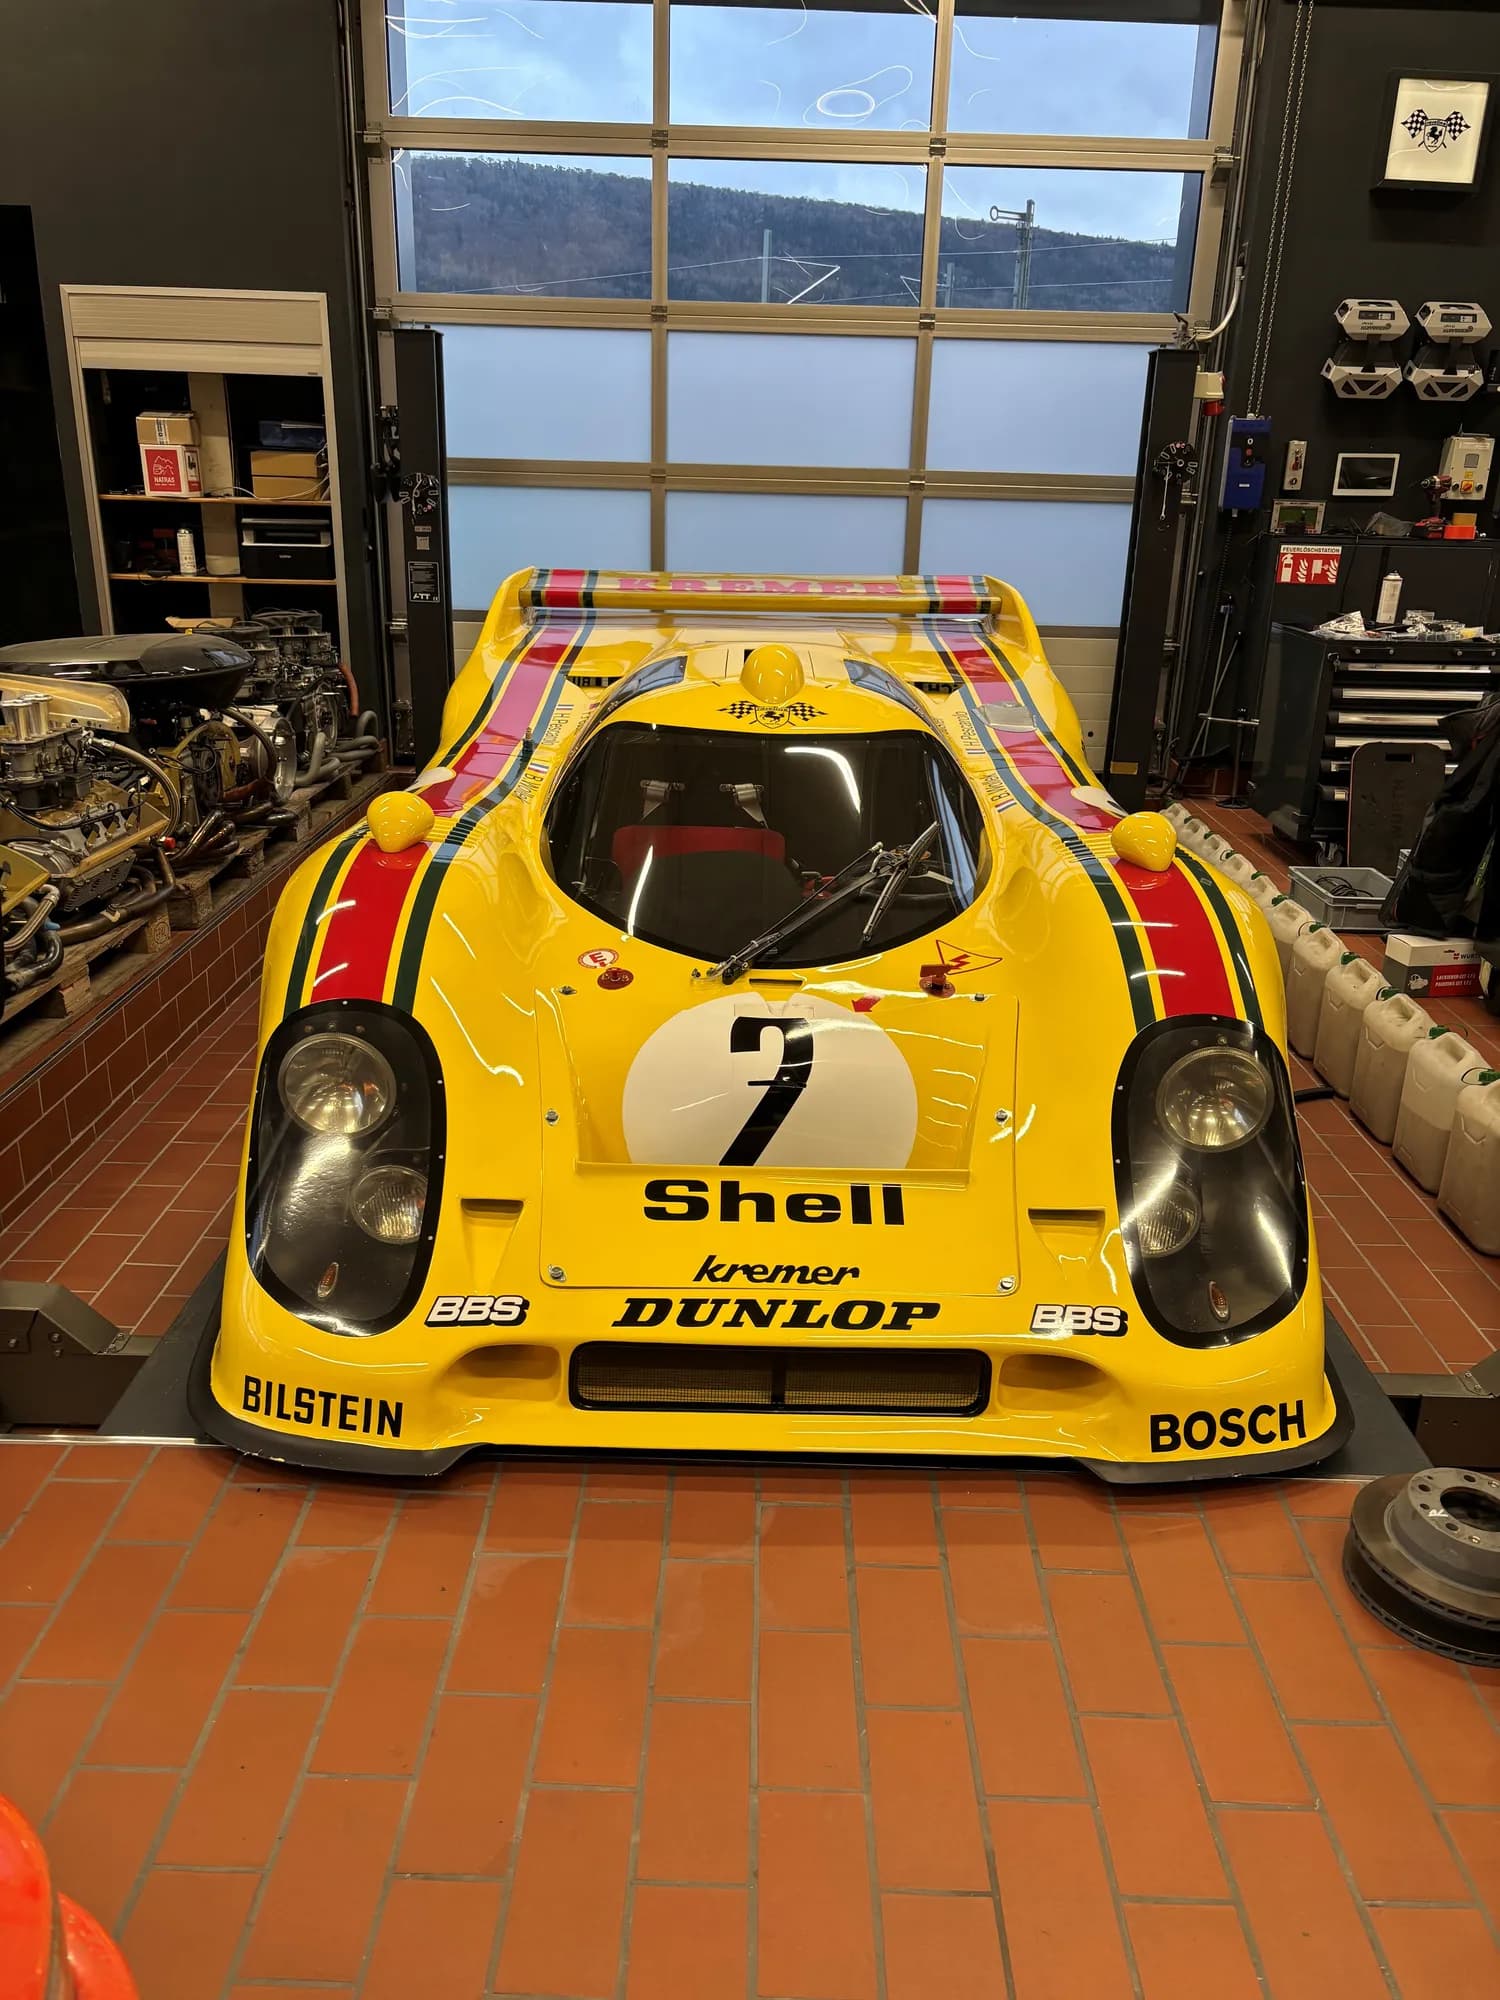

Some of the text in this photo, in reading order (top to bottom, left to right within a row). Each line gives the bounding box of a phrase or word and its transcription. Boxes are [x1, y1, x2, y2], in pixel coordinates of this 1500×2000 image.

[618, 578, 899, 596] KREMER
[643, 1179, 905, 1226] Shell
[692, 1254, 861, 1285] kremer
[424, 1295, 529, 1327] BBS
[611, 1297, 941, 1331] DUNLOP
[1029, 1304, 1129, 1337] BBS
[242, 1375, 403, 1438] BILSTEIN
[1149, 1400, 1307, 1453] BOSCH
